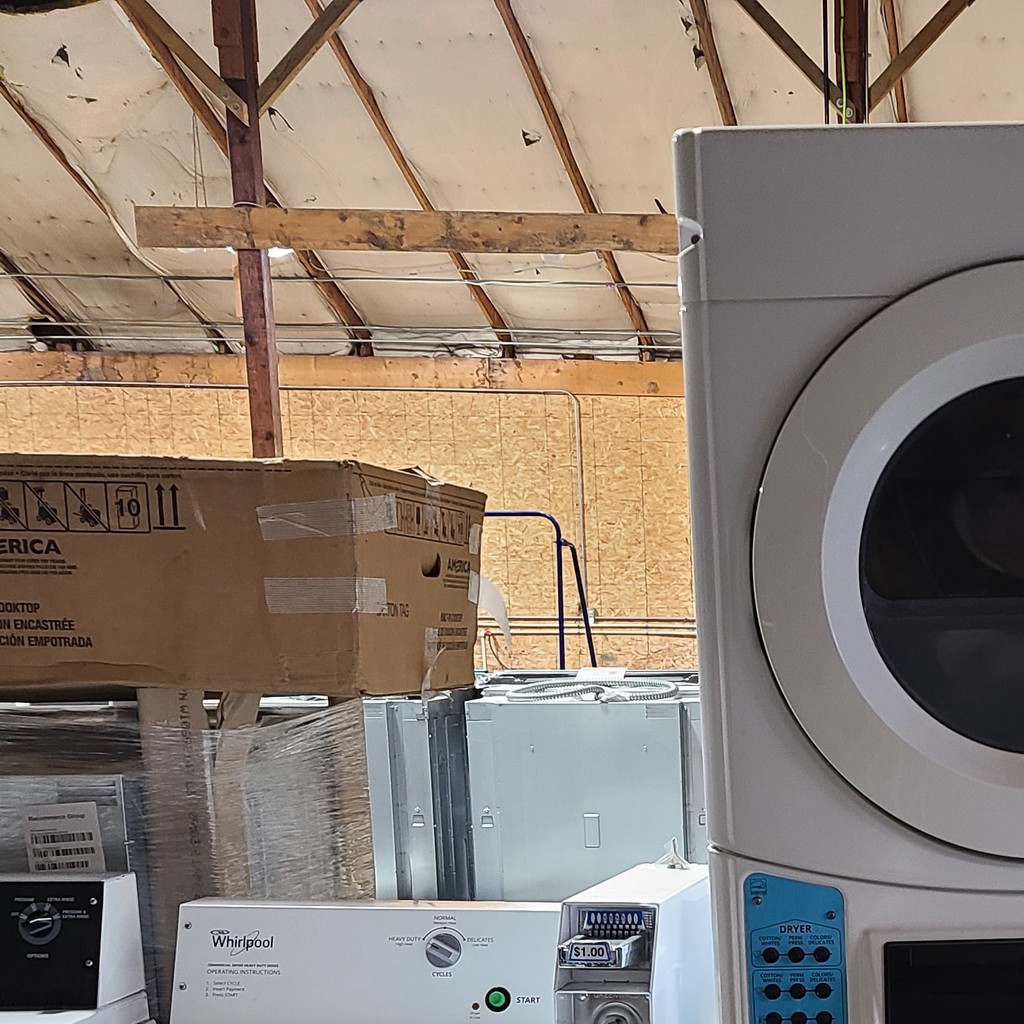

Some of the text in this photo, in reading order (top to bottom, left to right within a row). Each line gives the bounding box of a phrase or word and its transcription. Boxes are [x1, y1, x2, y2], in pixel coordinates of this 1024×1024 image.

[115, 498, 141, 518] 10
[14, 618, 75, 631] ENCASTRÉE
[28, 636, 93, 648] EMPOTRADA
[780, 924, 812, 934] DRYER
[212, 933, 274, 952] Whirlpool
[573, 947, 605, 958] $1.00
